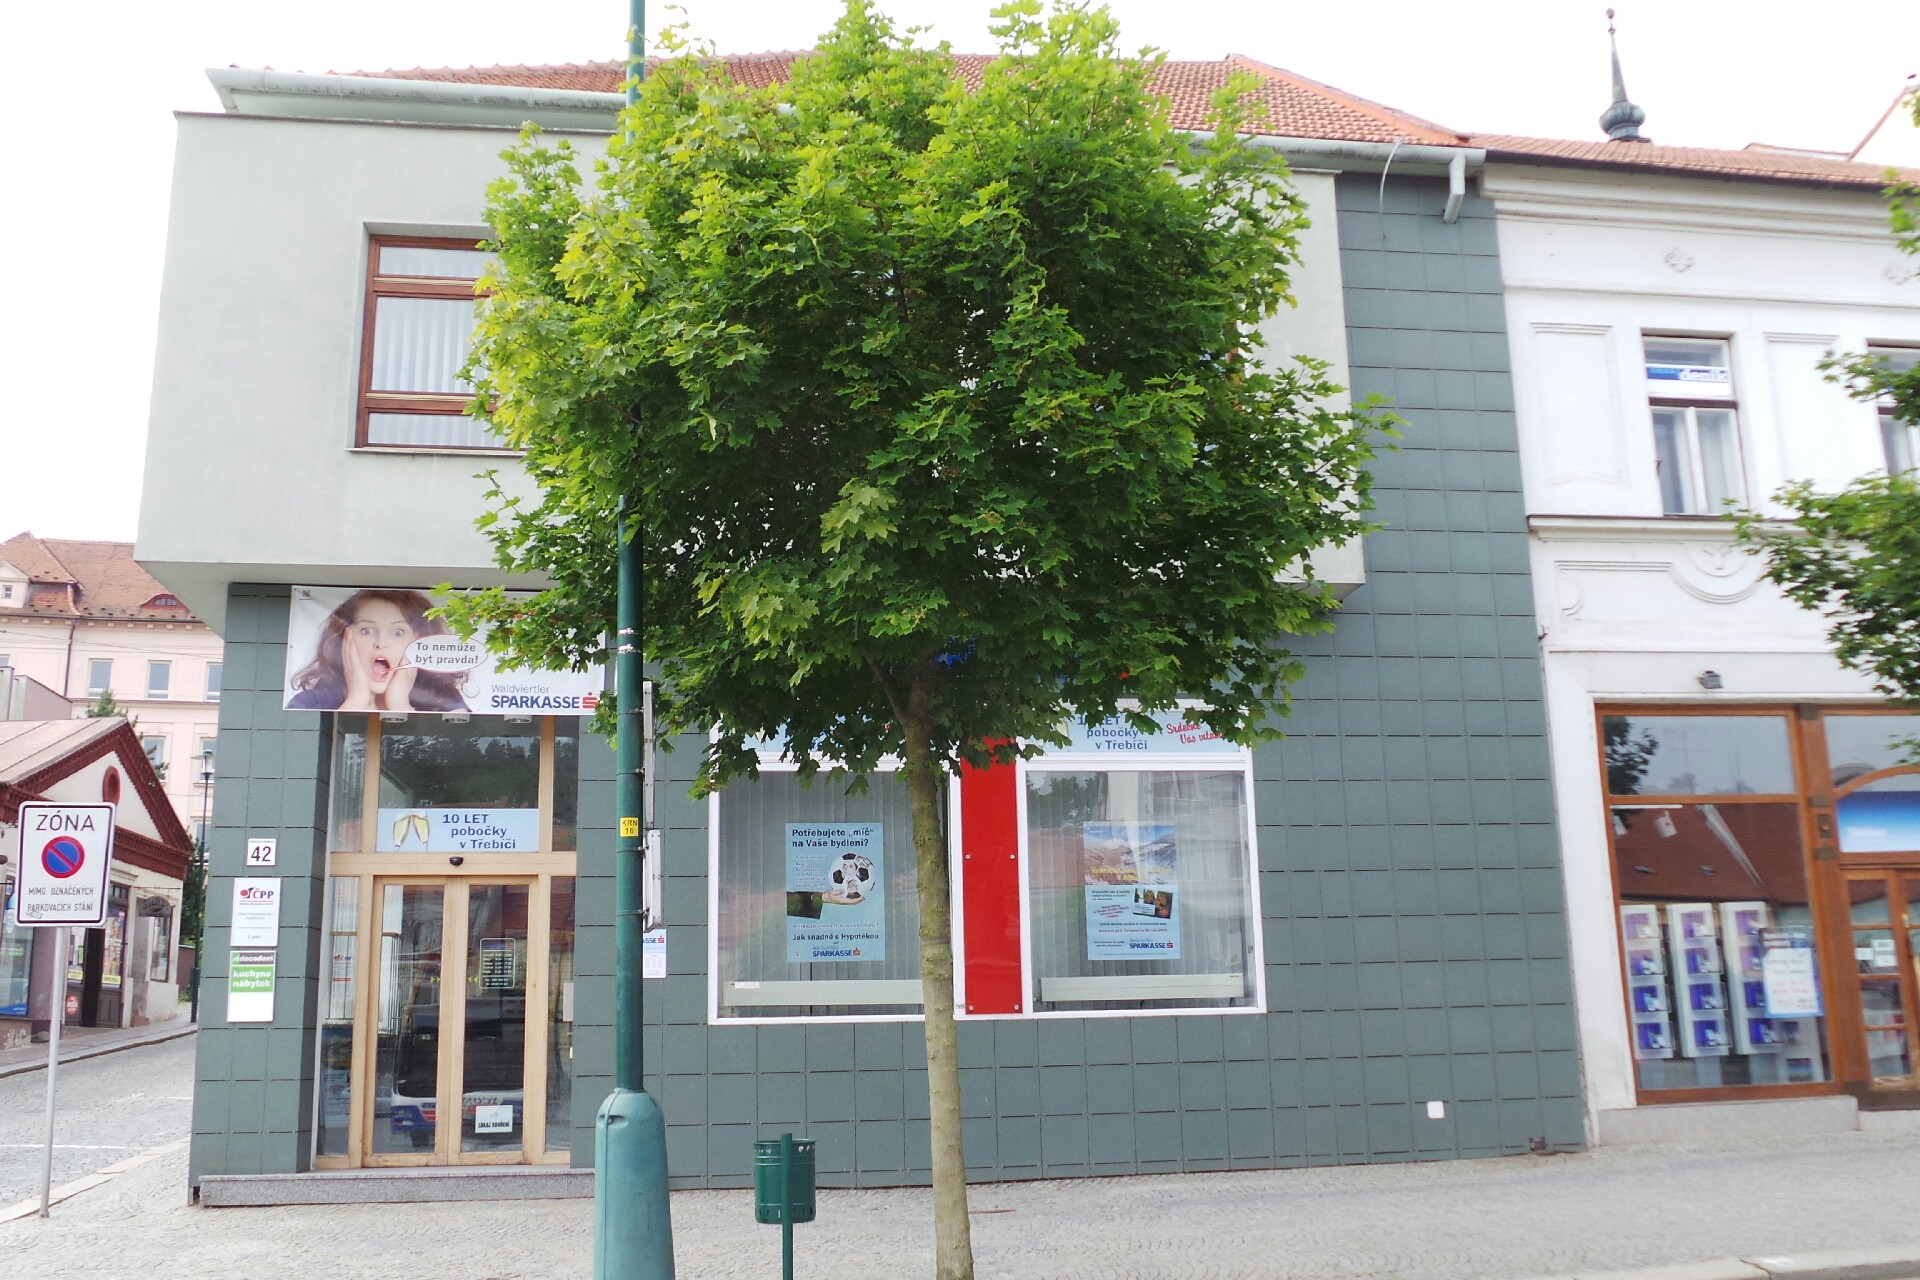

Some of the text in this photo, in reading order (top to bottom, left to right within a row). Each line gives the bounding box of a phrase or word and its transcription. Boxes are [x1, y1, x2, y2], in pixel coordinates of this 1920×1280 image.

[416, 642, 429, 652] To
[415, 653, 479, 665] být pravda!
[491, 684, 550, 694] Waldviertler
[491, 695, 579, 709] SPARKASSE
[1086, 727, 1139, 739] pobočky
[1105, 740, 1148, 749] Třebíči
[36, 810, 95, 832] ZÓNA
[442, 814, 489, 824] 10 LET
[451, 825, 507, 838] pobočky
[624, 827, 634, 835] 16
[792, 828, 846, 839] Potřebujete
[459, 838, 516, 849] v Třebíči
[806, 838, 828, 847] Vaše
[830, 838, 869, 849] bydlení?
[251, 846, 272, 862] 42
[28, 885, 94, 896] MIMO OZNAČENÝCH
[252, 888, 274, 899] ČPP
[27, 901, 93, 912] PARKOVACÍCH STÁNÍ
[841, 932, 879, 941] Hypotékou
[812, 949, 852, 957] SPARKASSE
[232, 979, 272, 988] nábytok
